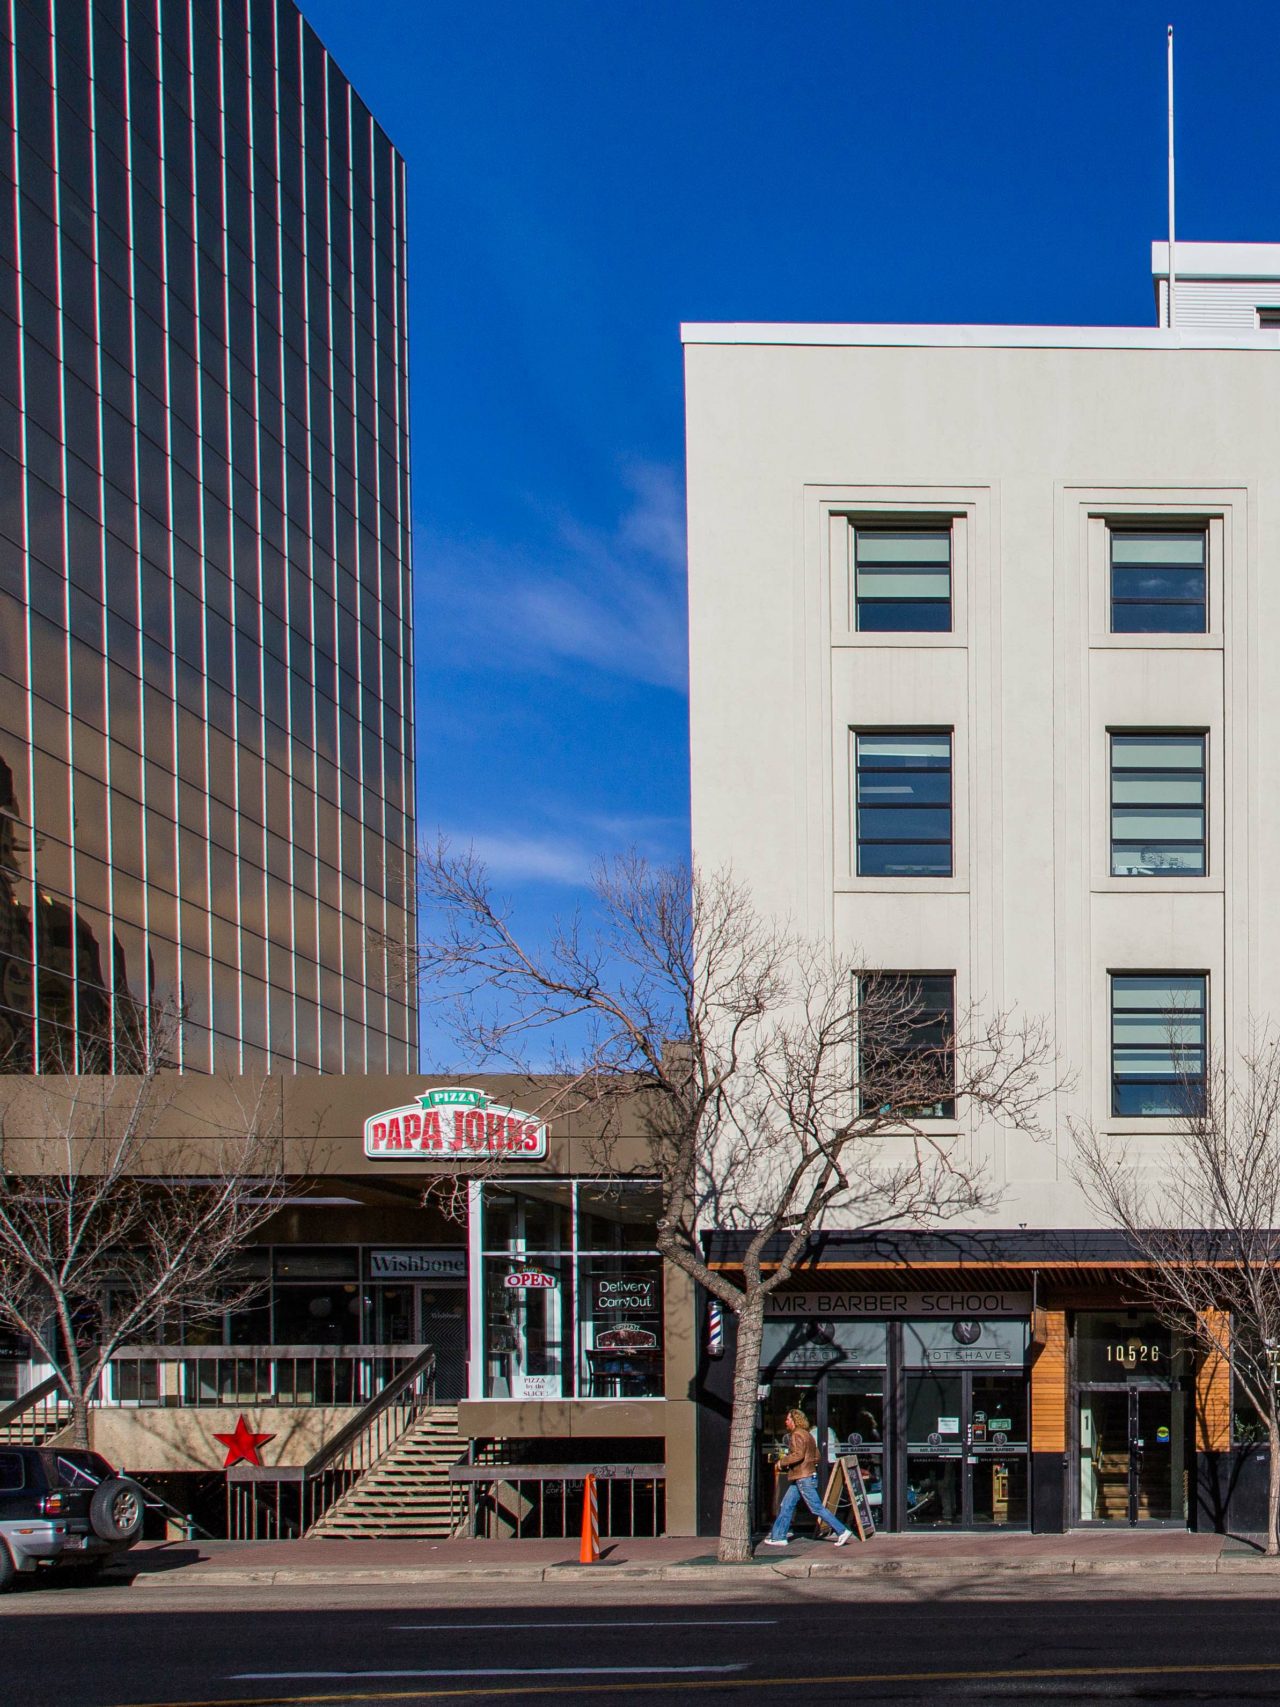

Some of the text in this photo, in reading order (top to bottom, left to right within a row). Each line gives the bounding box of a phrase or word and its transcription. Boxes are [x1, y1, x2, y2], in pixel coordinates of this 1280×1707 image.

[434, 1093, 476, 1103] PIZZA
[372, 1111, 443, 1151] PAPA
[372, 1256, 464, 1272] Wishbone
[507, 1273, 554, 1287] OPEN
[599, 1281, 650, 1294] Delivery
[599, 1296, 652, 1309] CarryOut
[772, 1294, 1013, 1312] MR. BARBER SCHOOL
[956, 1351, 1011, 1360] SHAVES
[1106, 1345, 1159, 1362] 10526
[1083, 1415, 1089, 1430] 1
